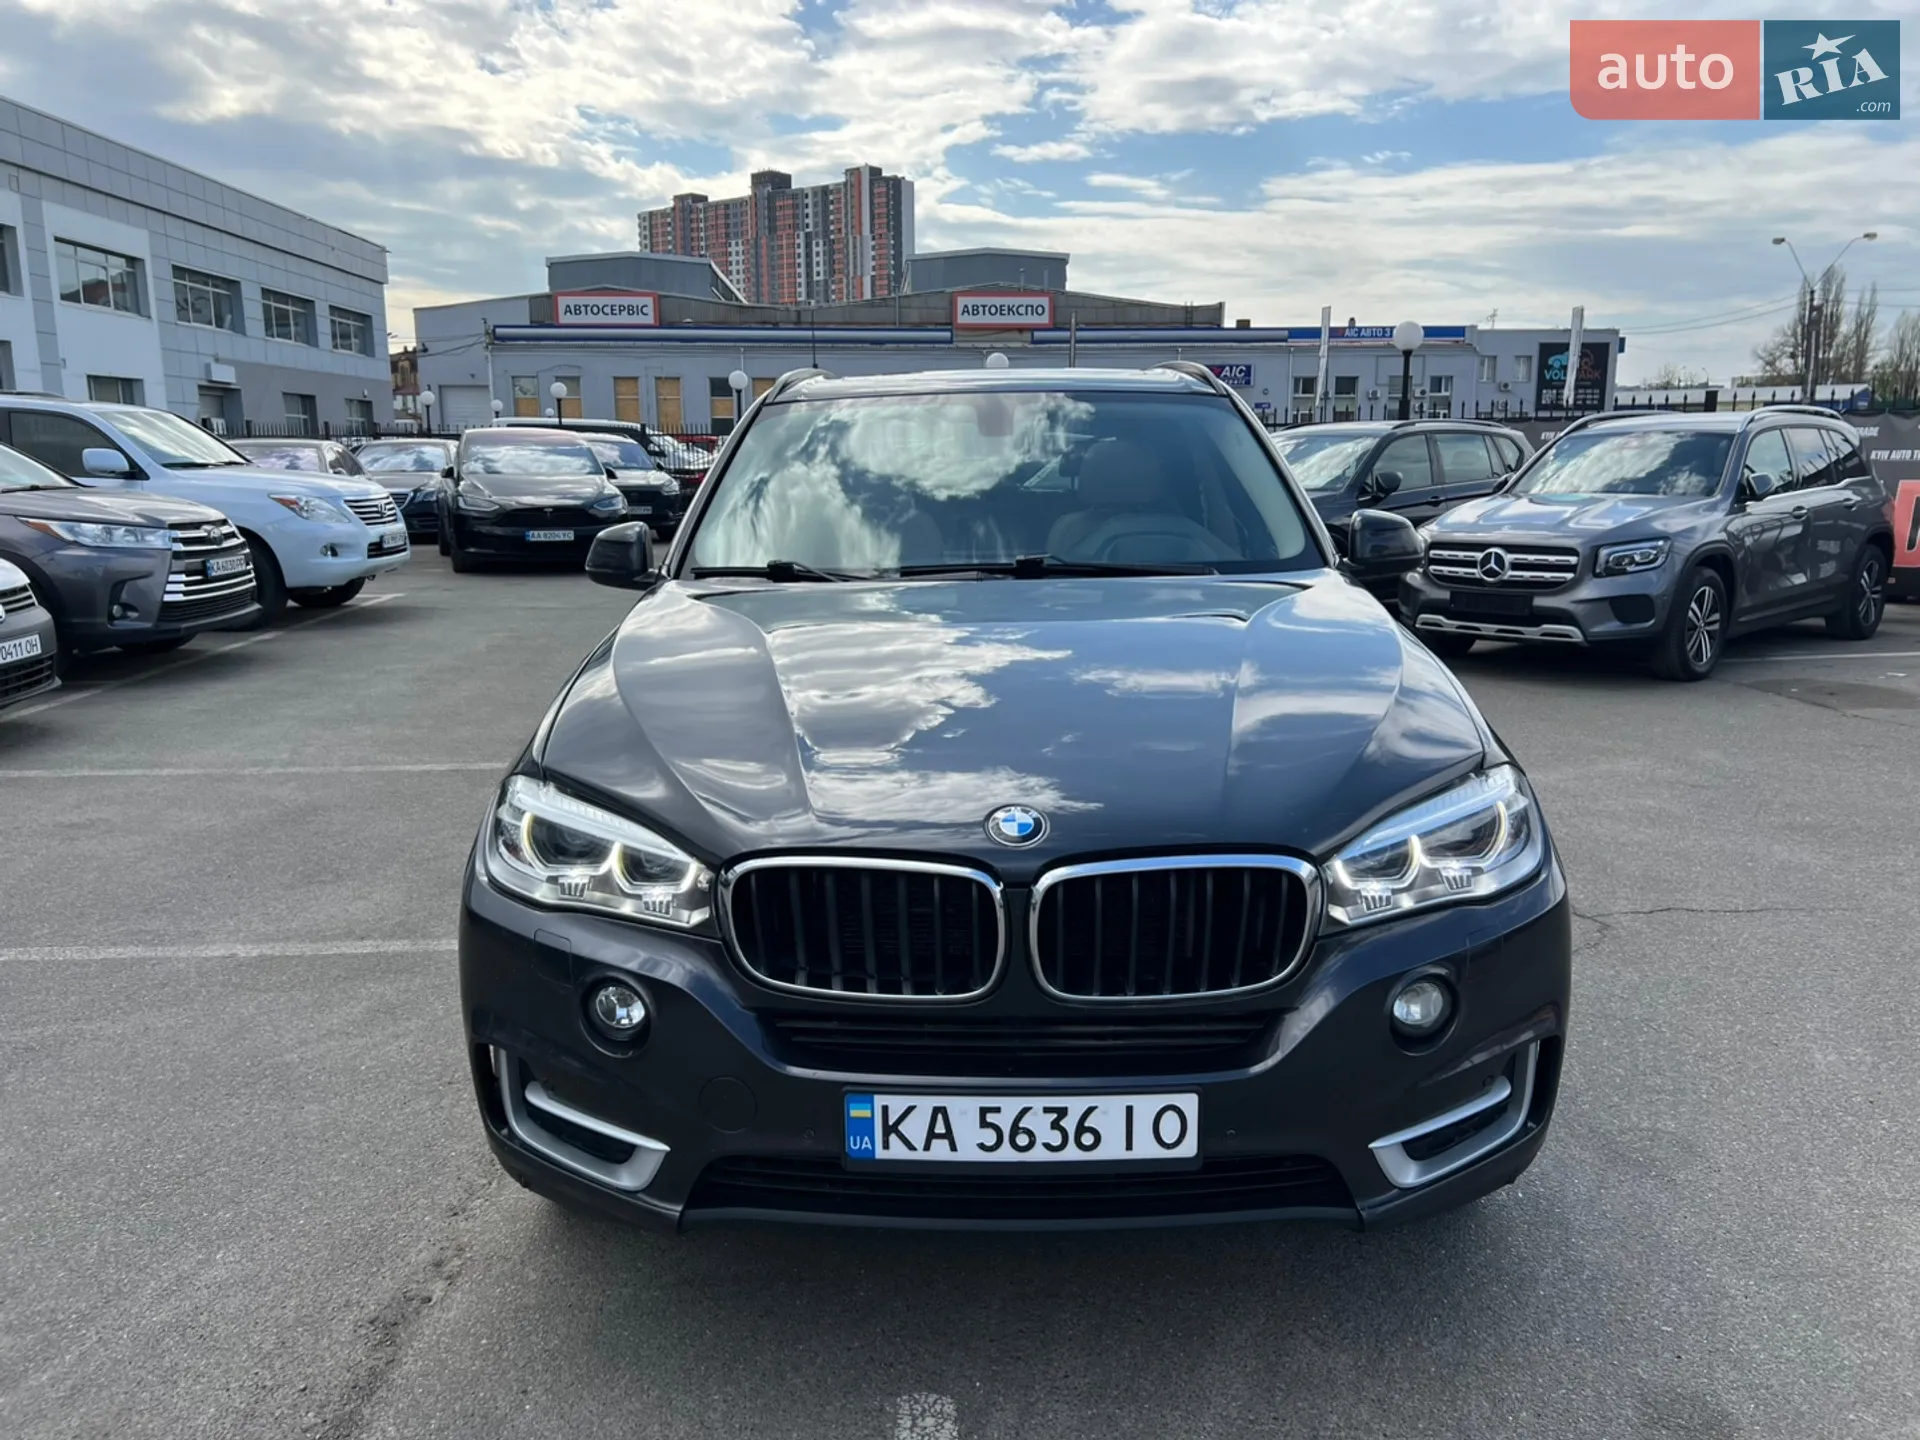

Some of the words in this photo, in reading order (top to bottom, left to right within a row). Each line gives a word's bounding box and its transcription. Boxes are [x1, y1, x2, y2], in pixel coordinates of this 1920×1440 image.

[563, 303, 649, 316] АВТОСЕРВІС
[961, 303, 1046, 317] АВТОЕКСПО
[880, 1104, 958, 1153] KA
[975, 1105, 1102, 1153] 5636
[1124, 1103, 1188, 1152] IO
[849, 1136, 873, 1151] UA
